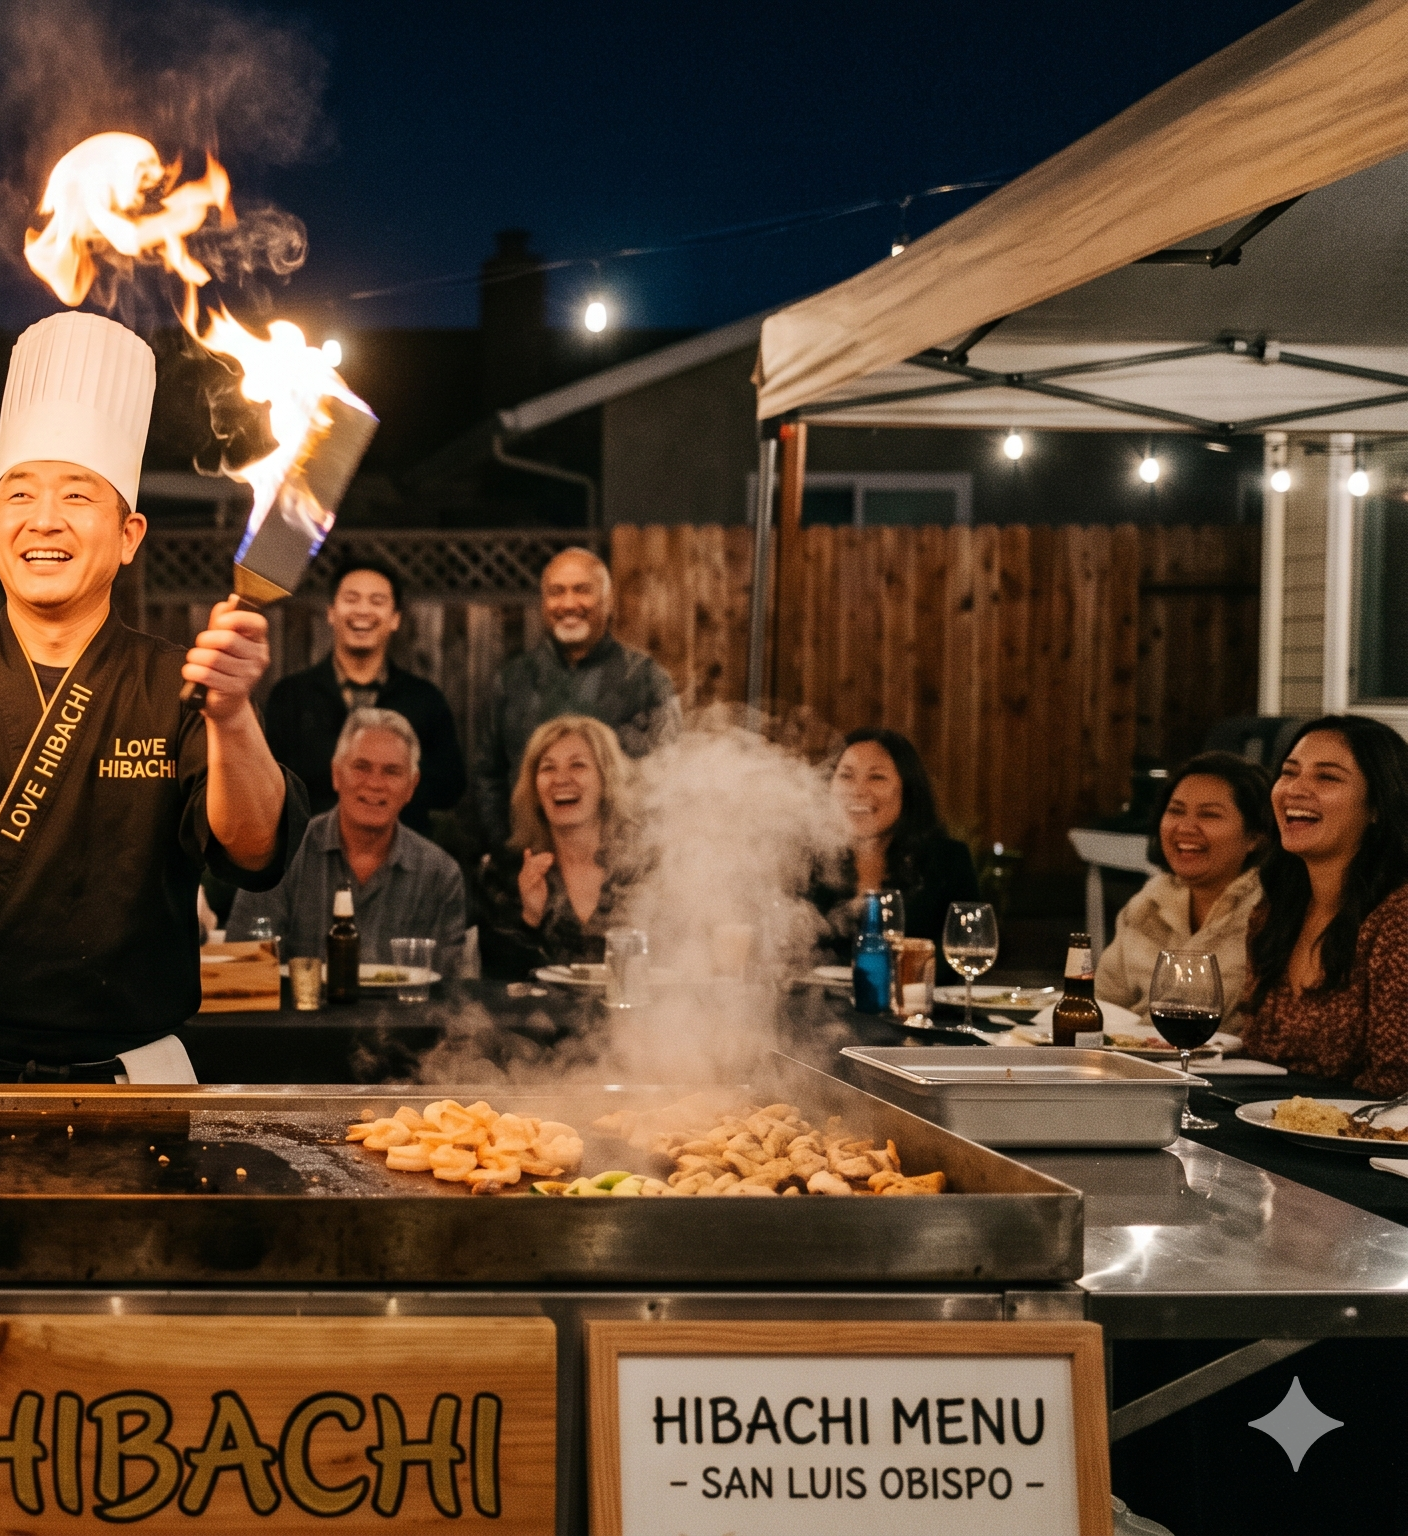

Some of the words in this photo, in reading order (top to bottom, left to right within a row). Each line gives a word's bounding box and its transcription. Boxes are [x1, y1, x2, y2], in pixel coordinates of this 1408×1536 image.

[0, 779, 46, 842] LOVE
[34, 683, 93, 778] HIBACHI
[114, 738, 167, 757] LOVE
[98, 759, 176, 779] HIBACHI
[652, 1396, 870, 1445] HIBACHI
[892, 1397, 1045, 1445] MENU
[702, 1466, 773, 1499] SAN
[788, 1467, 867, 1499] LUIS
[880, 1466, 1013, 1500] OBISPO
